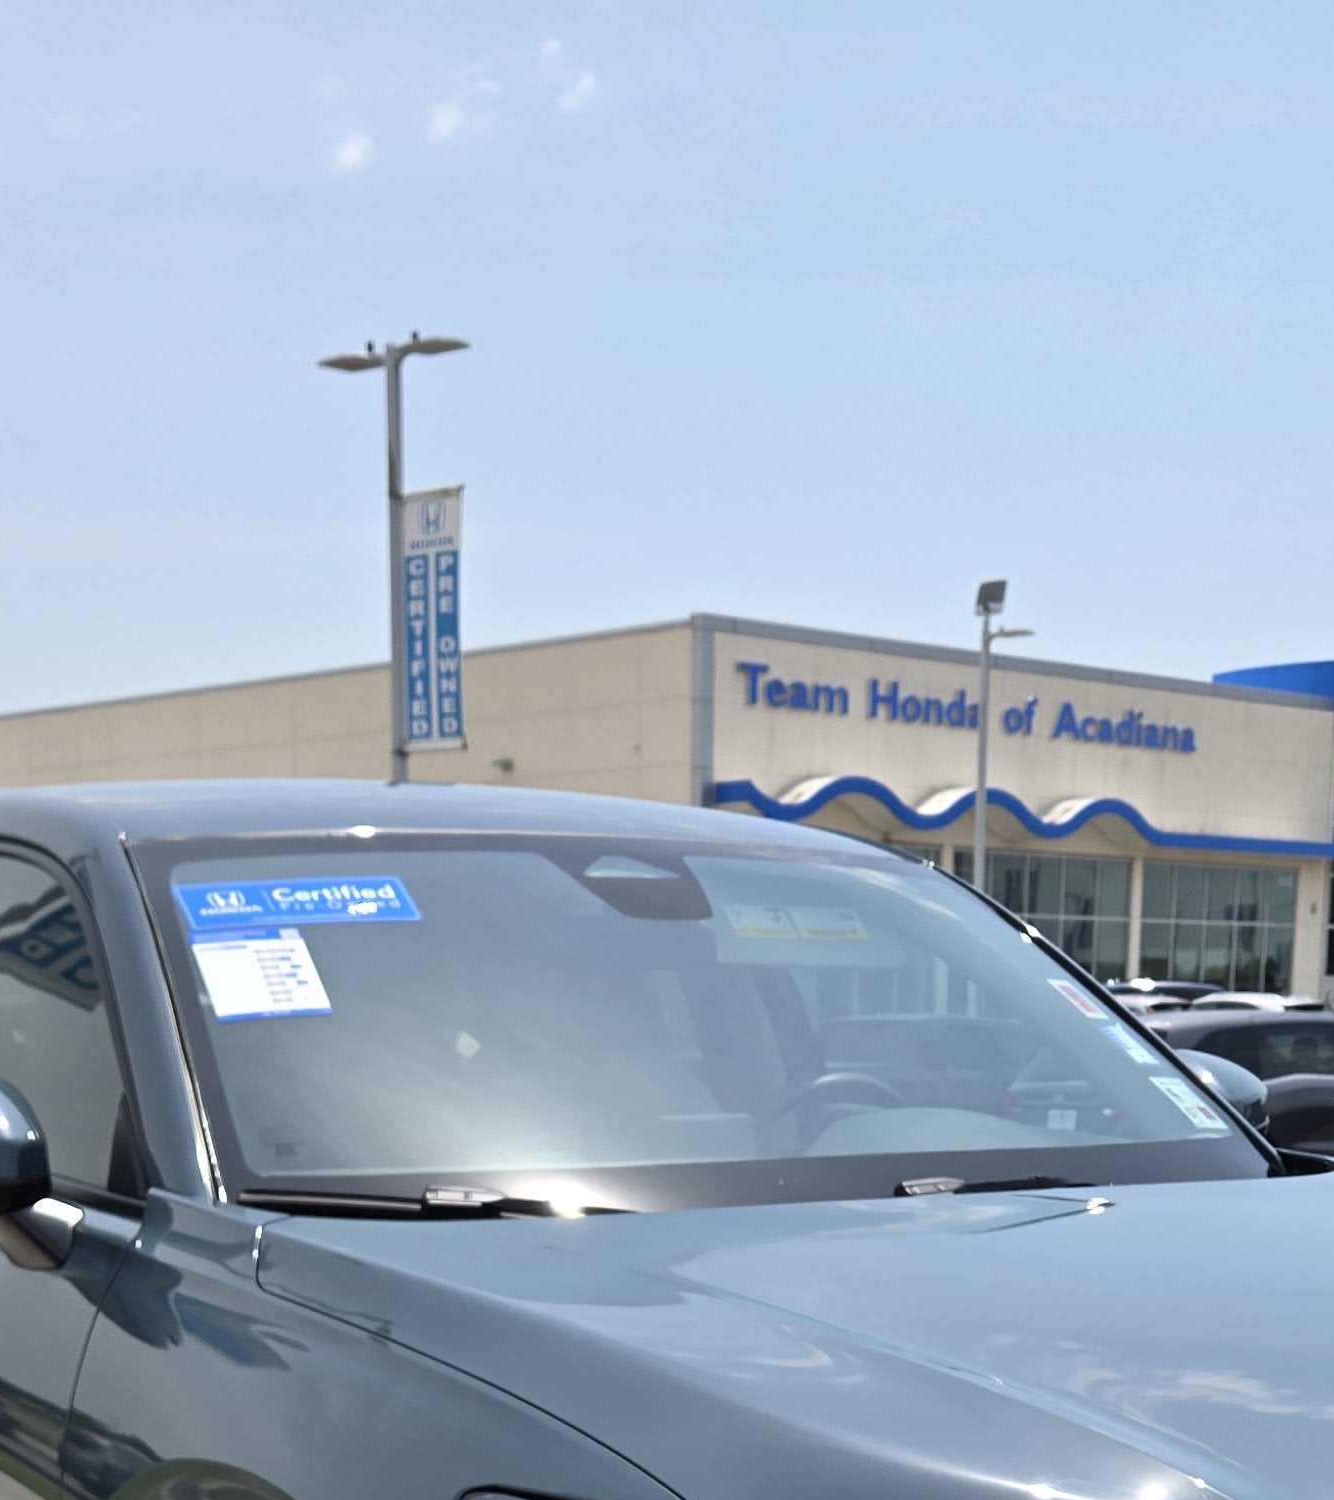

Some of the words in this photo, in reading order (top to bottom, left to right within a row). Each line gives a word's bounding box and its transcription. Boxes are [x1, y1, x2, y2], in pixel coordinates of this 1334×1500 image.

[438, 554, 455, 614] PRE
[409, 558, 428, 736] CERTIFIED
[438, 636, 459, 734] OWNED
[736, 661, 850, 716] Team
[1003, 698, 1038, 737] of
[1051, 701, 1197, 753] Acadiana
[271, 883, 397, 902] Certified
